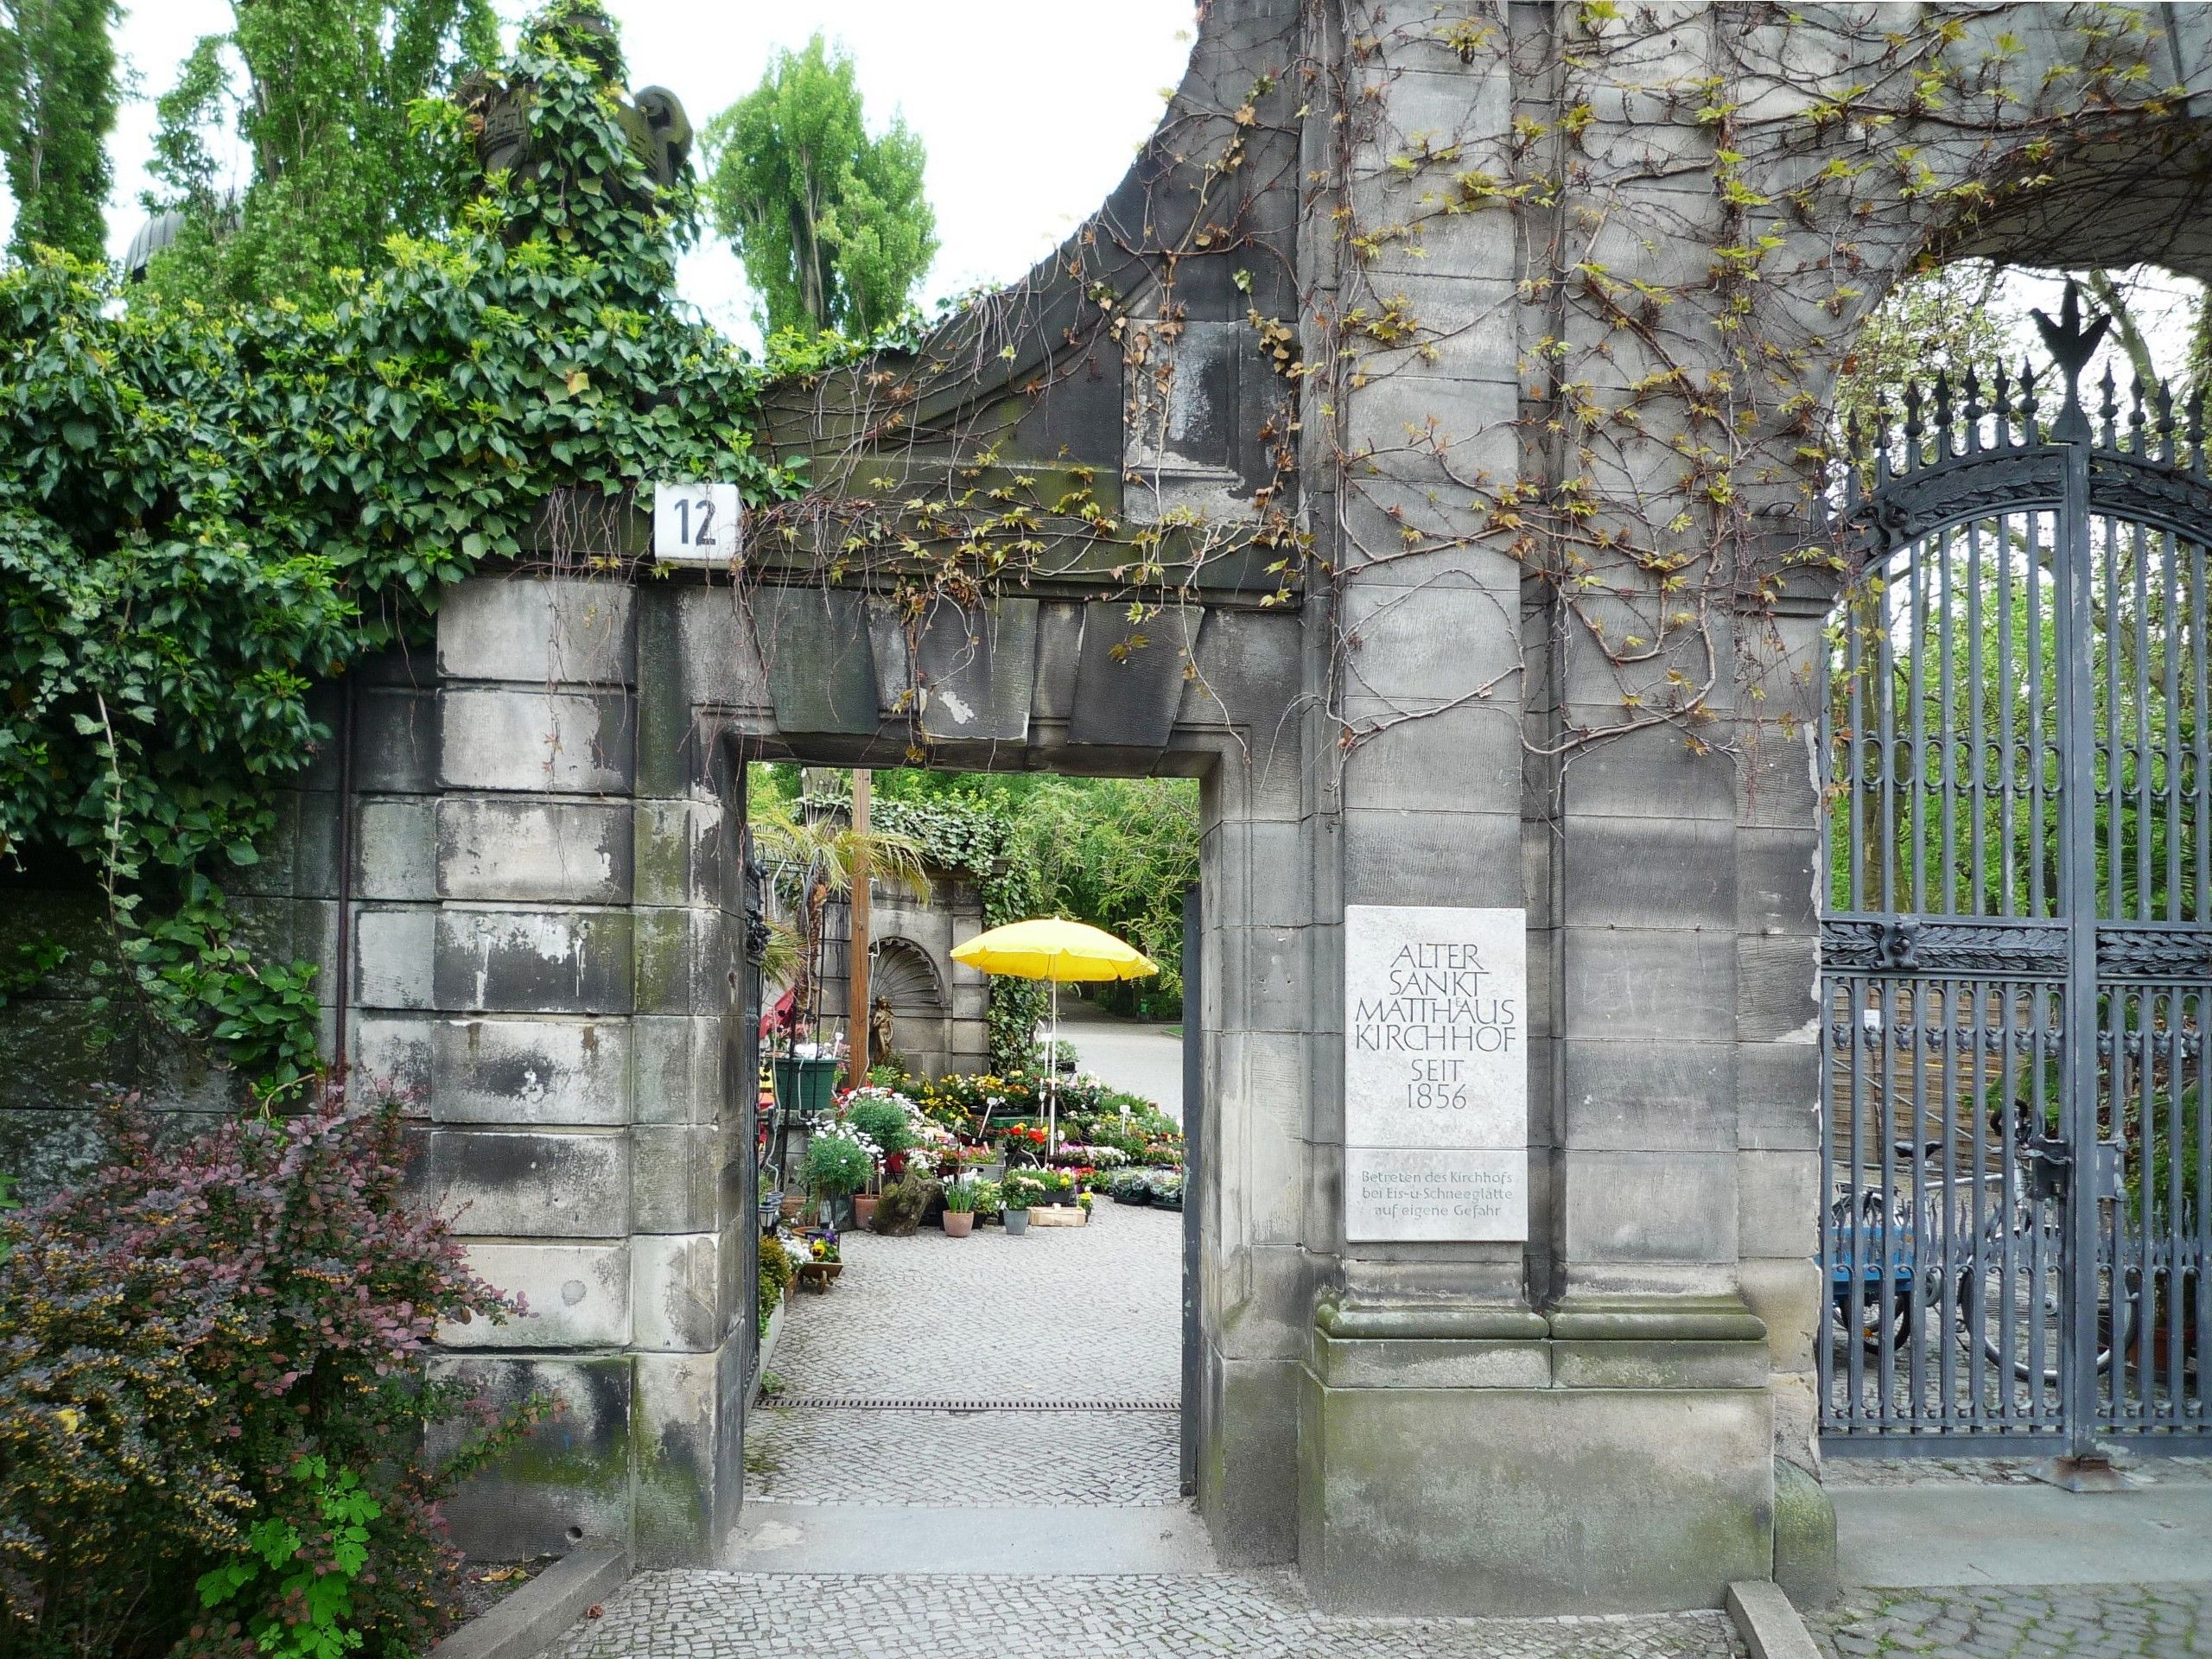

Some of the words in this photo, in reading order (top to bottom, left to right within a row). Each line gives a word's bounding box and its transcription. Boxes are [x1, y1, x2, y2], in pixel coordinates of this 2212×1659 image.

[674, 499, 716, 546] 12
[1390, 943, 1484, 970] ALTER
[1389, 969, 1491, 997] SANKT
[1356, 1024, 1516, 1052] KIRCHHOF
[1411, 1058, 1465, 1082] SEIT
[1408, 1083, 1466, 1109] 1856
[1362, 1170, 1421, 1184] Betreten
[1425, 1172, 1447, 1184] des
[1451, 1171, 1513, 1185] Kirchhofs
[1363, 1186, 1382, 1199] bei
[1375, 1204, 1399, 1219] auf
[1402, 1205, 1449, 1220] eigene
[1453, 1205, 1502, 1219] Gefahr
